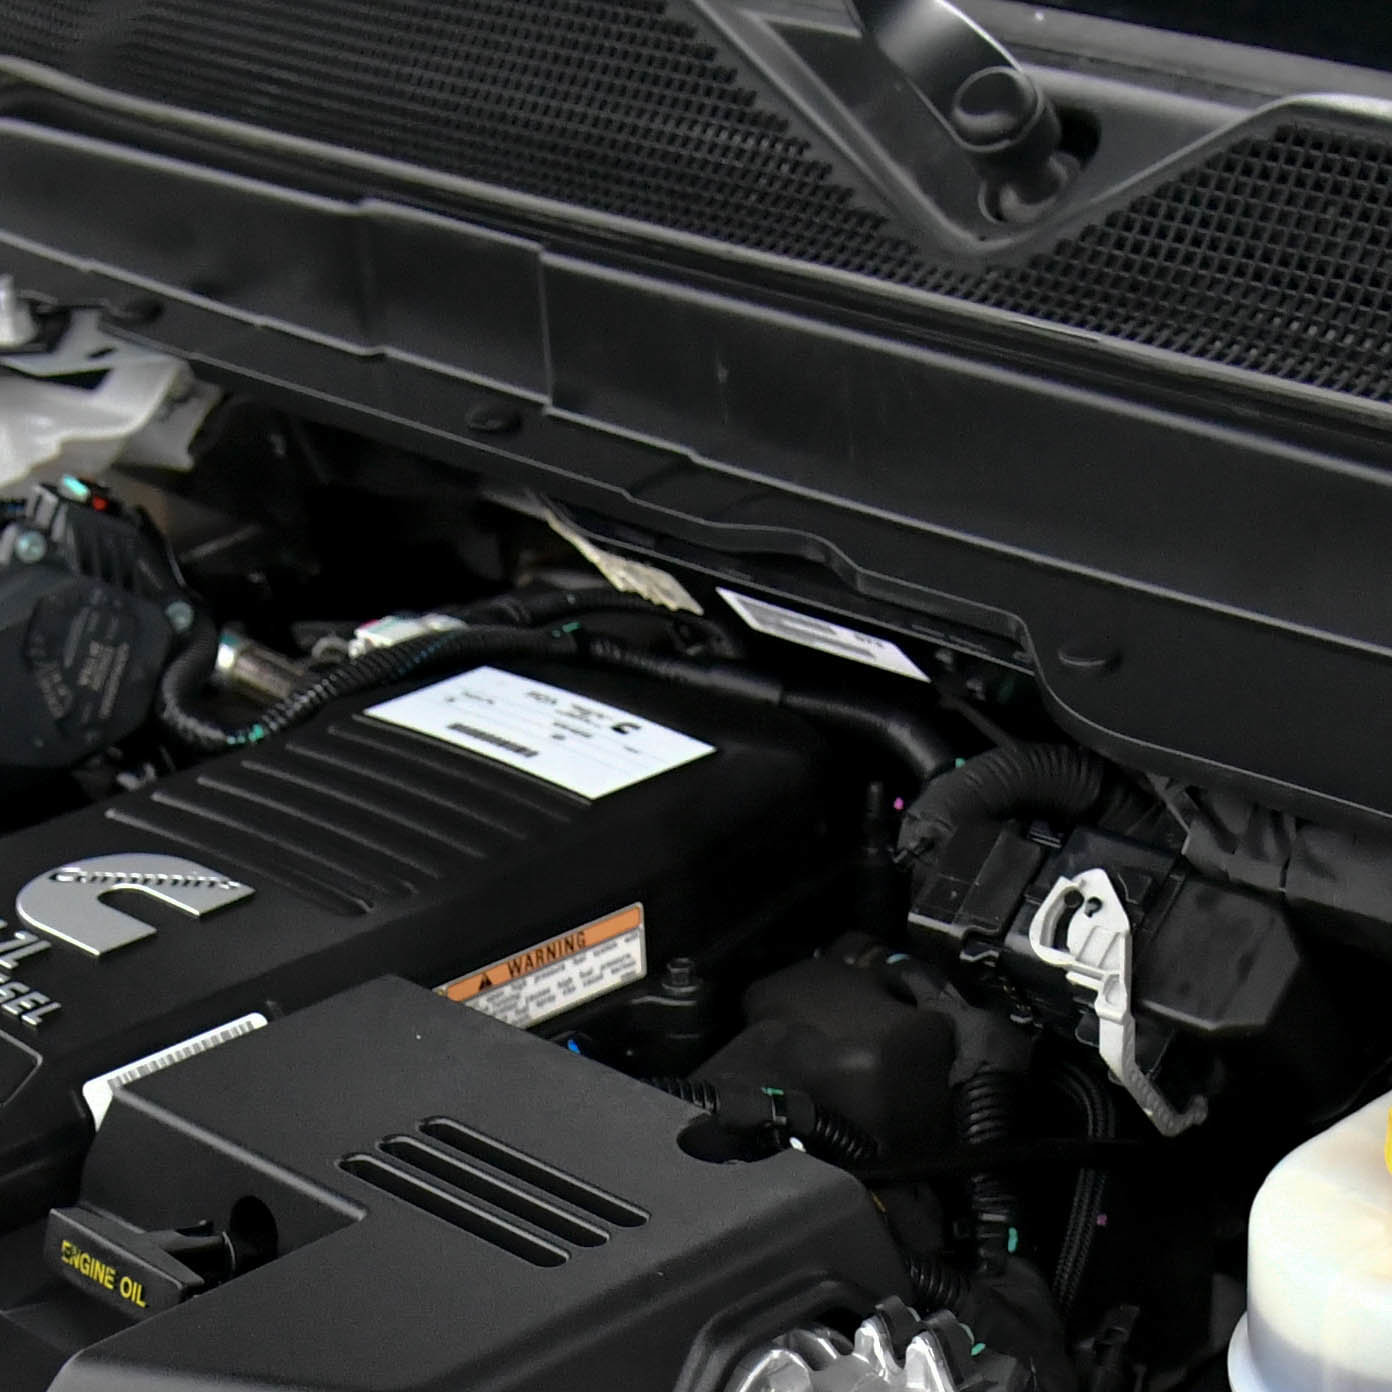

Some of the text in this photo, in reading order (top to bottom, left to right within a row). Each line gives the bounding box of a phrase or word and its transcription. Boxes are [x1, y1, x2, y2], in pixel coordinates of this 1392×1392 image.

[508, 932, 586, 978] WARNING
[61, 1240, 147, 1308] ENGINE OIL
